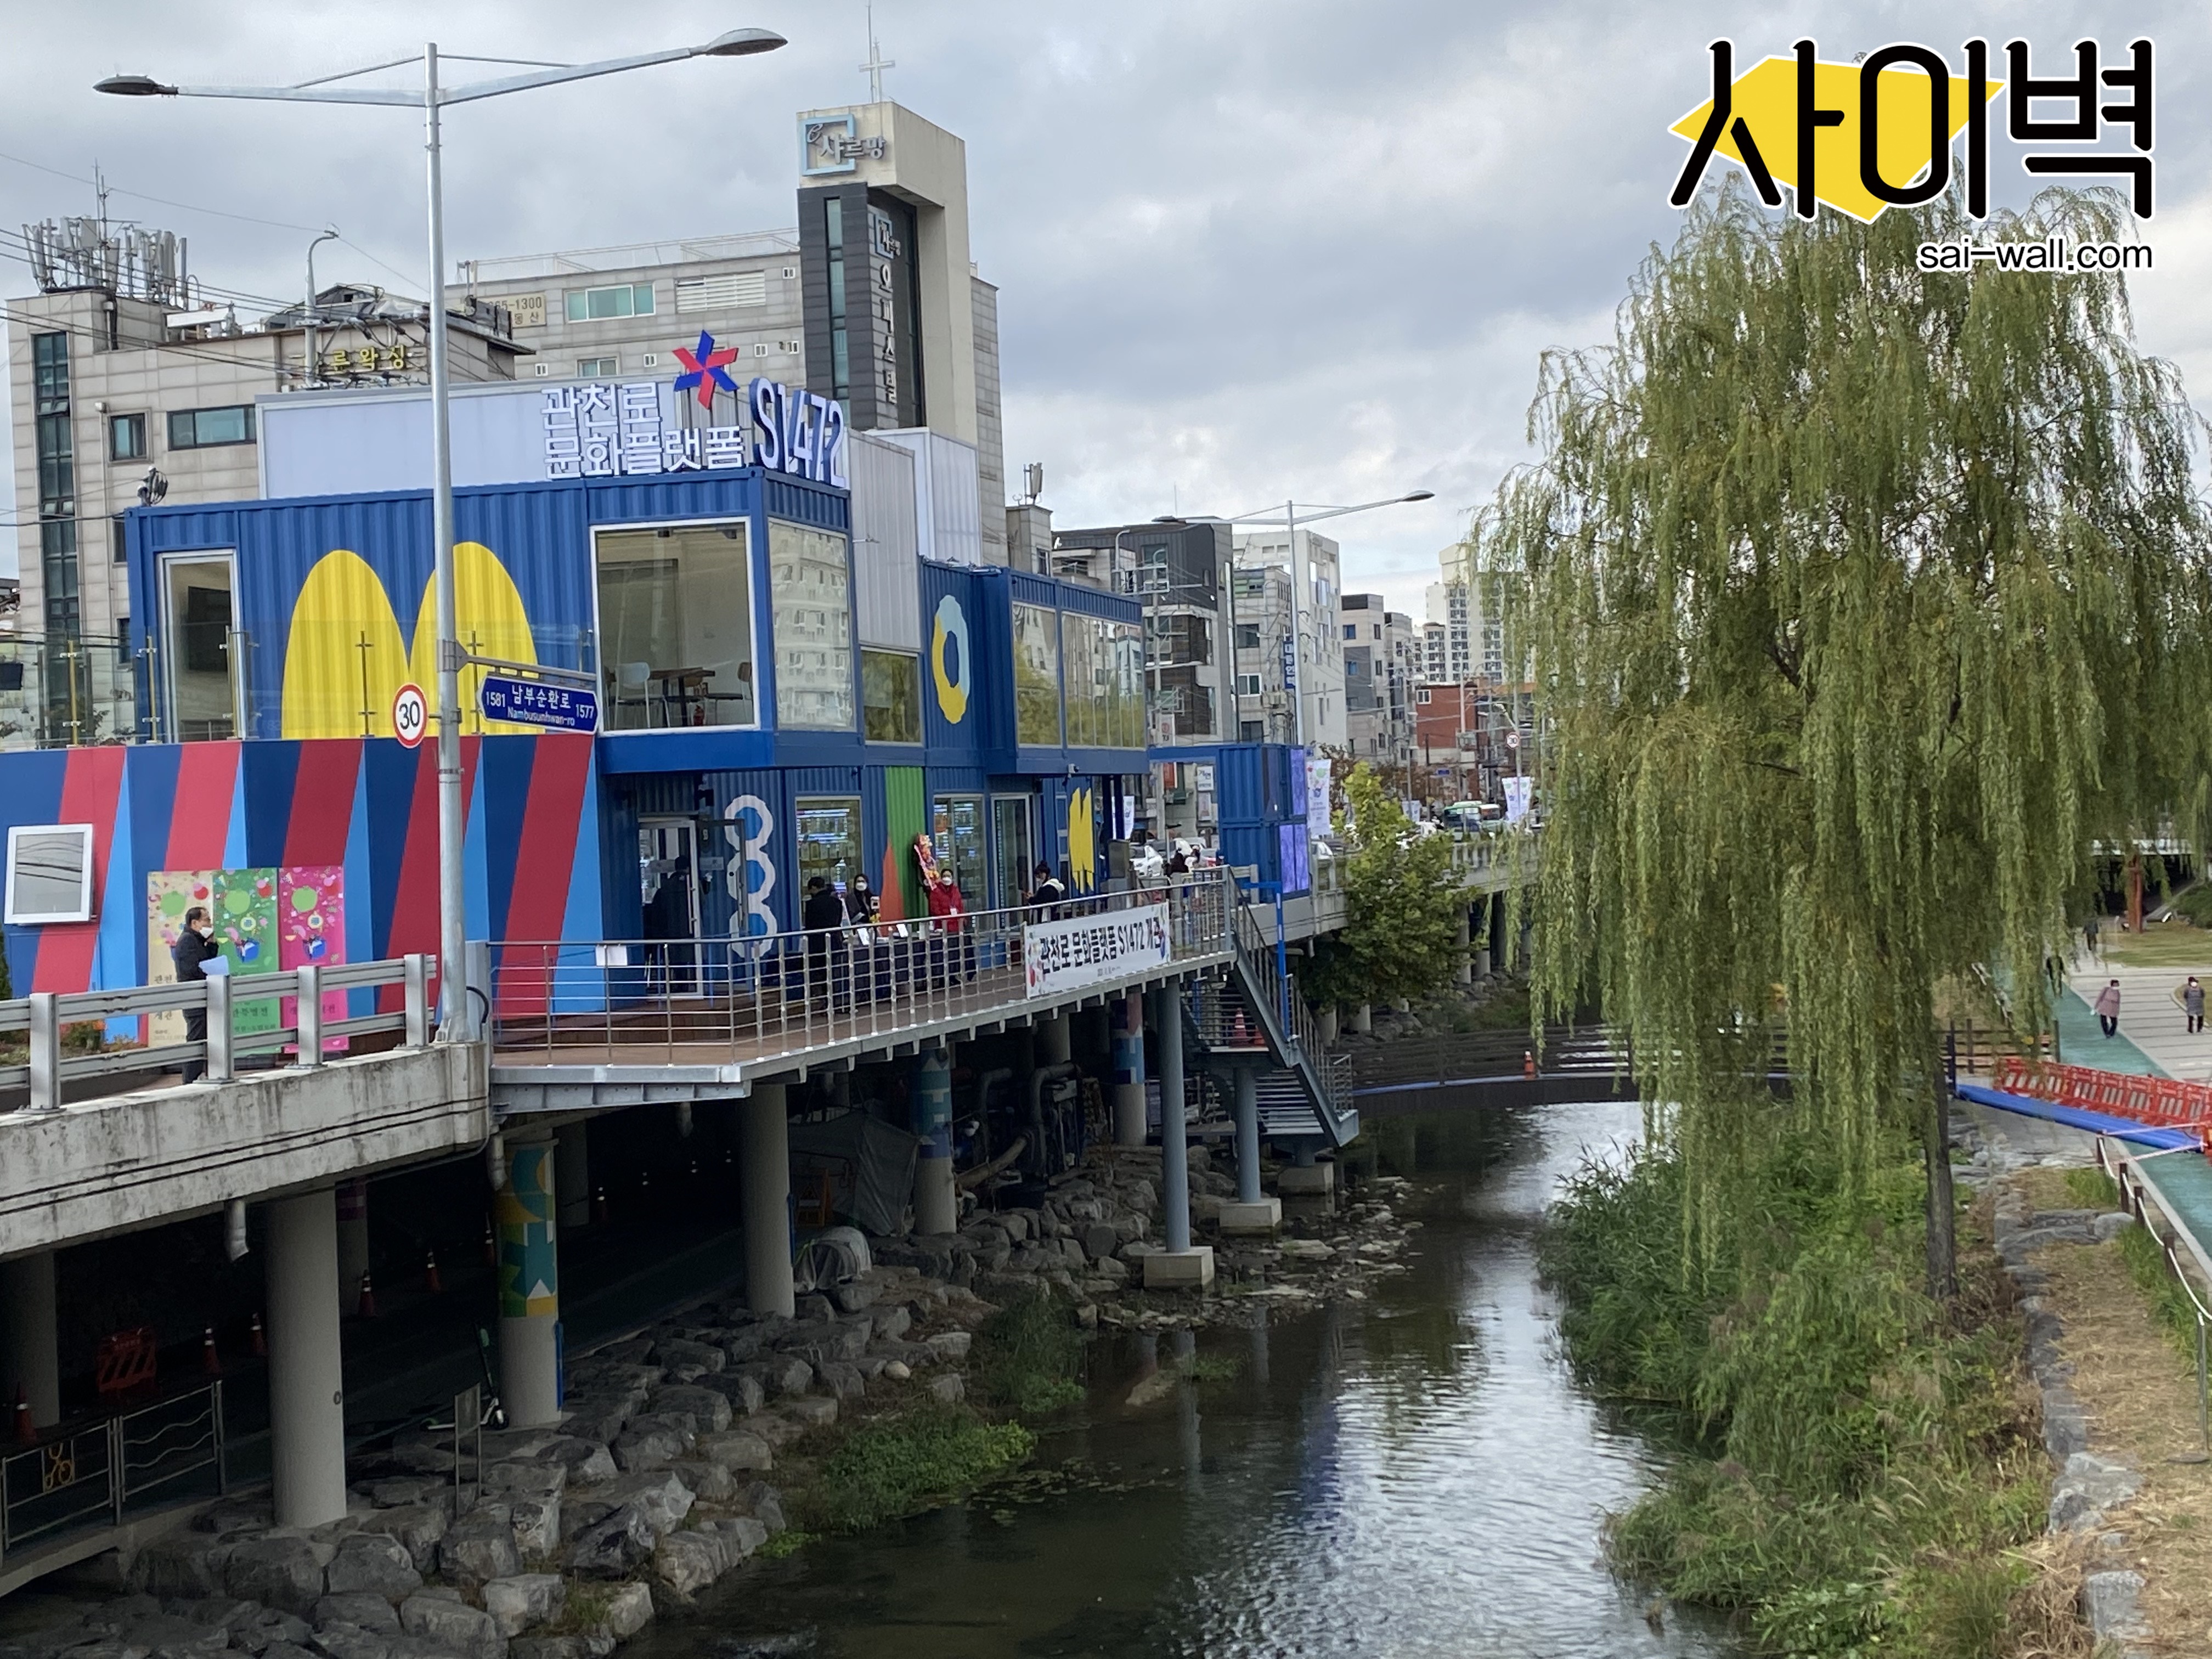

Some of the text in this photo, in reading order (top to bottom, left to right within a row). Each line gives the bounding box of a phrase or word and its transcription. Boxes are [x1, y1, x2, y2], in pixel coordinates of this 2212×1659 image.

[879, 263, 898, 405] 오피스텔
[541, 382, 662, 431] 관천로
[544, 425, 746, 481] 문화플랫폼
[750, 377, 848, 489] S1472
[398, 701, 421, 730] 30
[486, 684, 594, 719] 1581 남부순환로 1577
